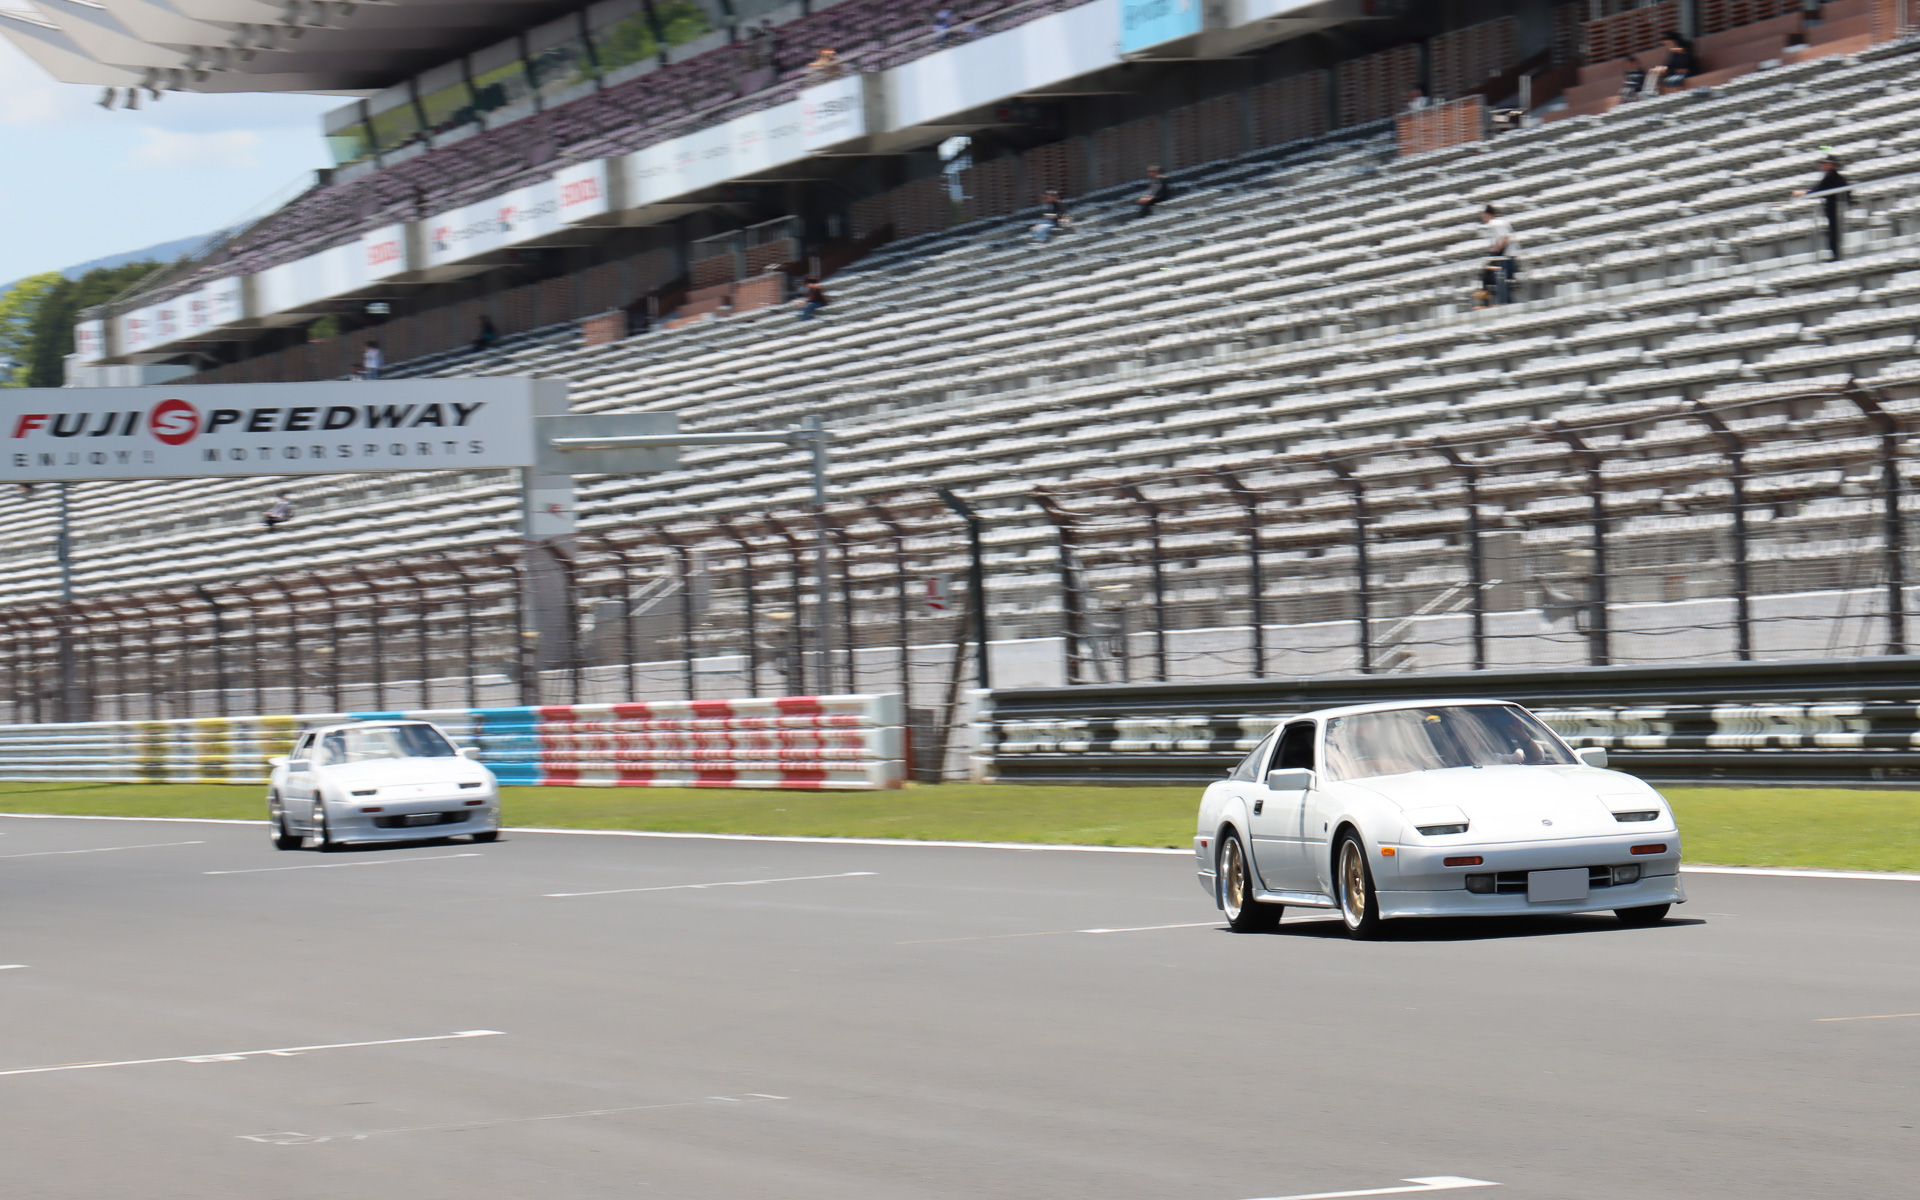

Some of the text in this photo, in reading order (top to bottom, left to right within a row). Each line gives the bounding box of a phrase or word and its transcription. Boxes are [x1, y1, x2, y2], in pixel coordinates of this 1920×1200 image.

[10, 400, 486, 442] FUJI SPEEDWAY
[203, 440, 485, 462] MOTORSPORTS
